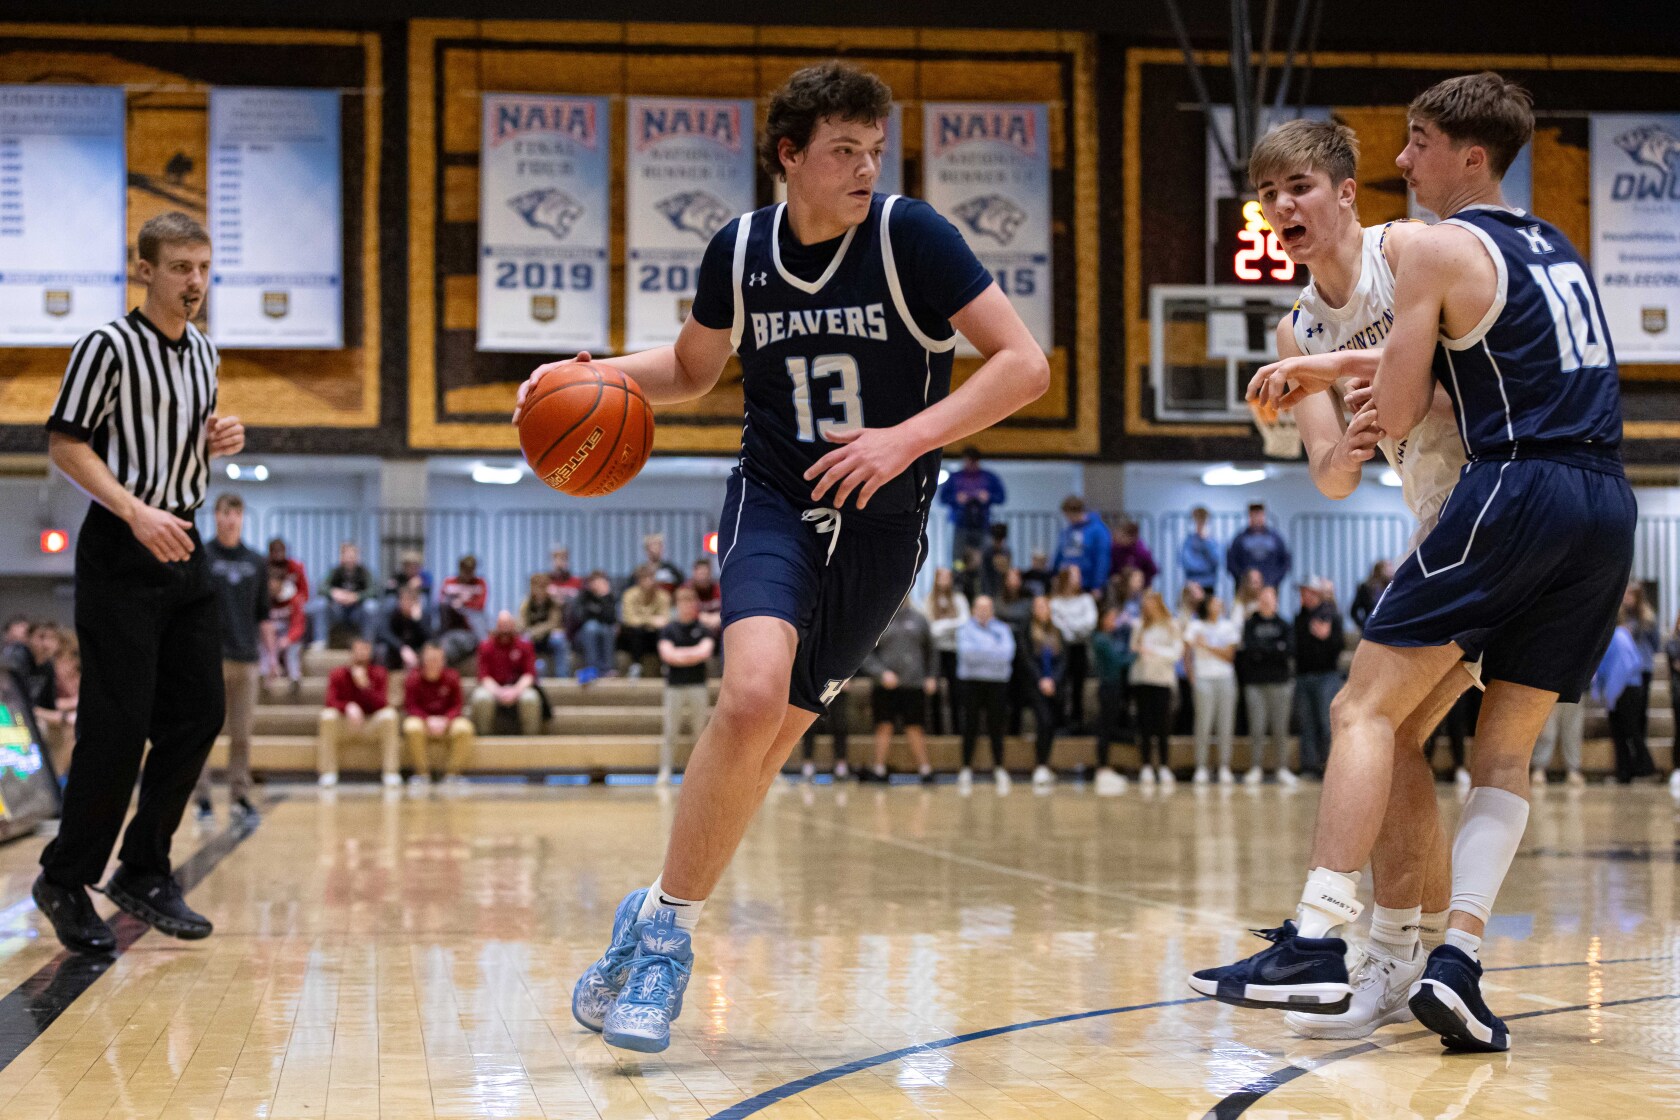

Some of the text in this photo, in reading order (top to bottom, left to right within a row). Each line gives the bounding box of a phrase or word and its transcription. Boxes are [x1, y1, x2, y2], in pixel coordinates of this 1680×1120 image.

[497, 104, 588, 137] NAIA
[643, 107, 733, 141] NAIA
[940, 112, 1028, 147] NAIA
[496, 262, 594, 290] 2019
[639, 264, 699, 292] 20
[751, 302, 888, 350] BEAVERS
[1527, 262, 1610, 373] 10
[785, 353, 865, 443] 13
